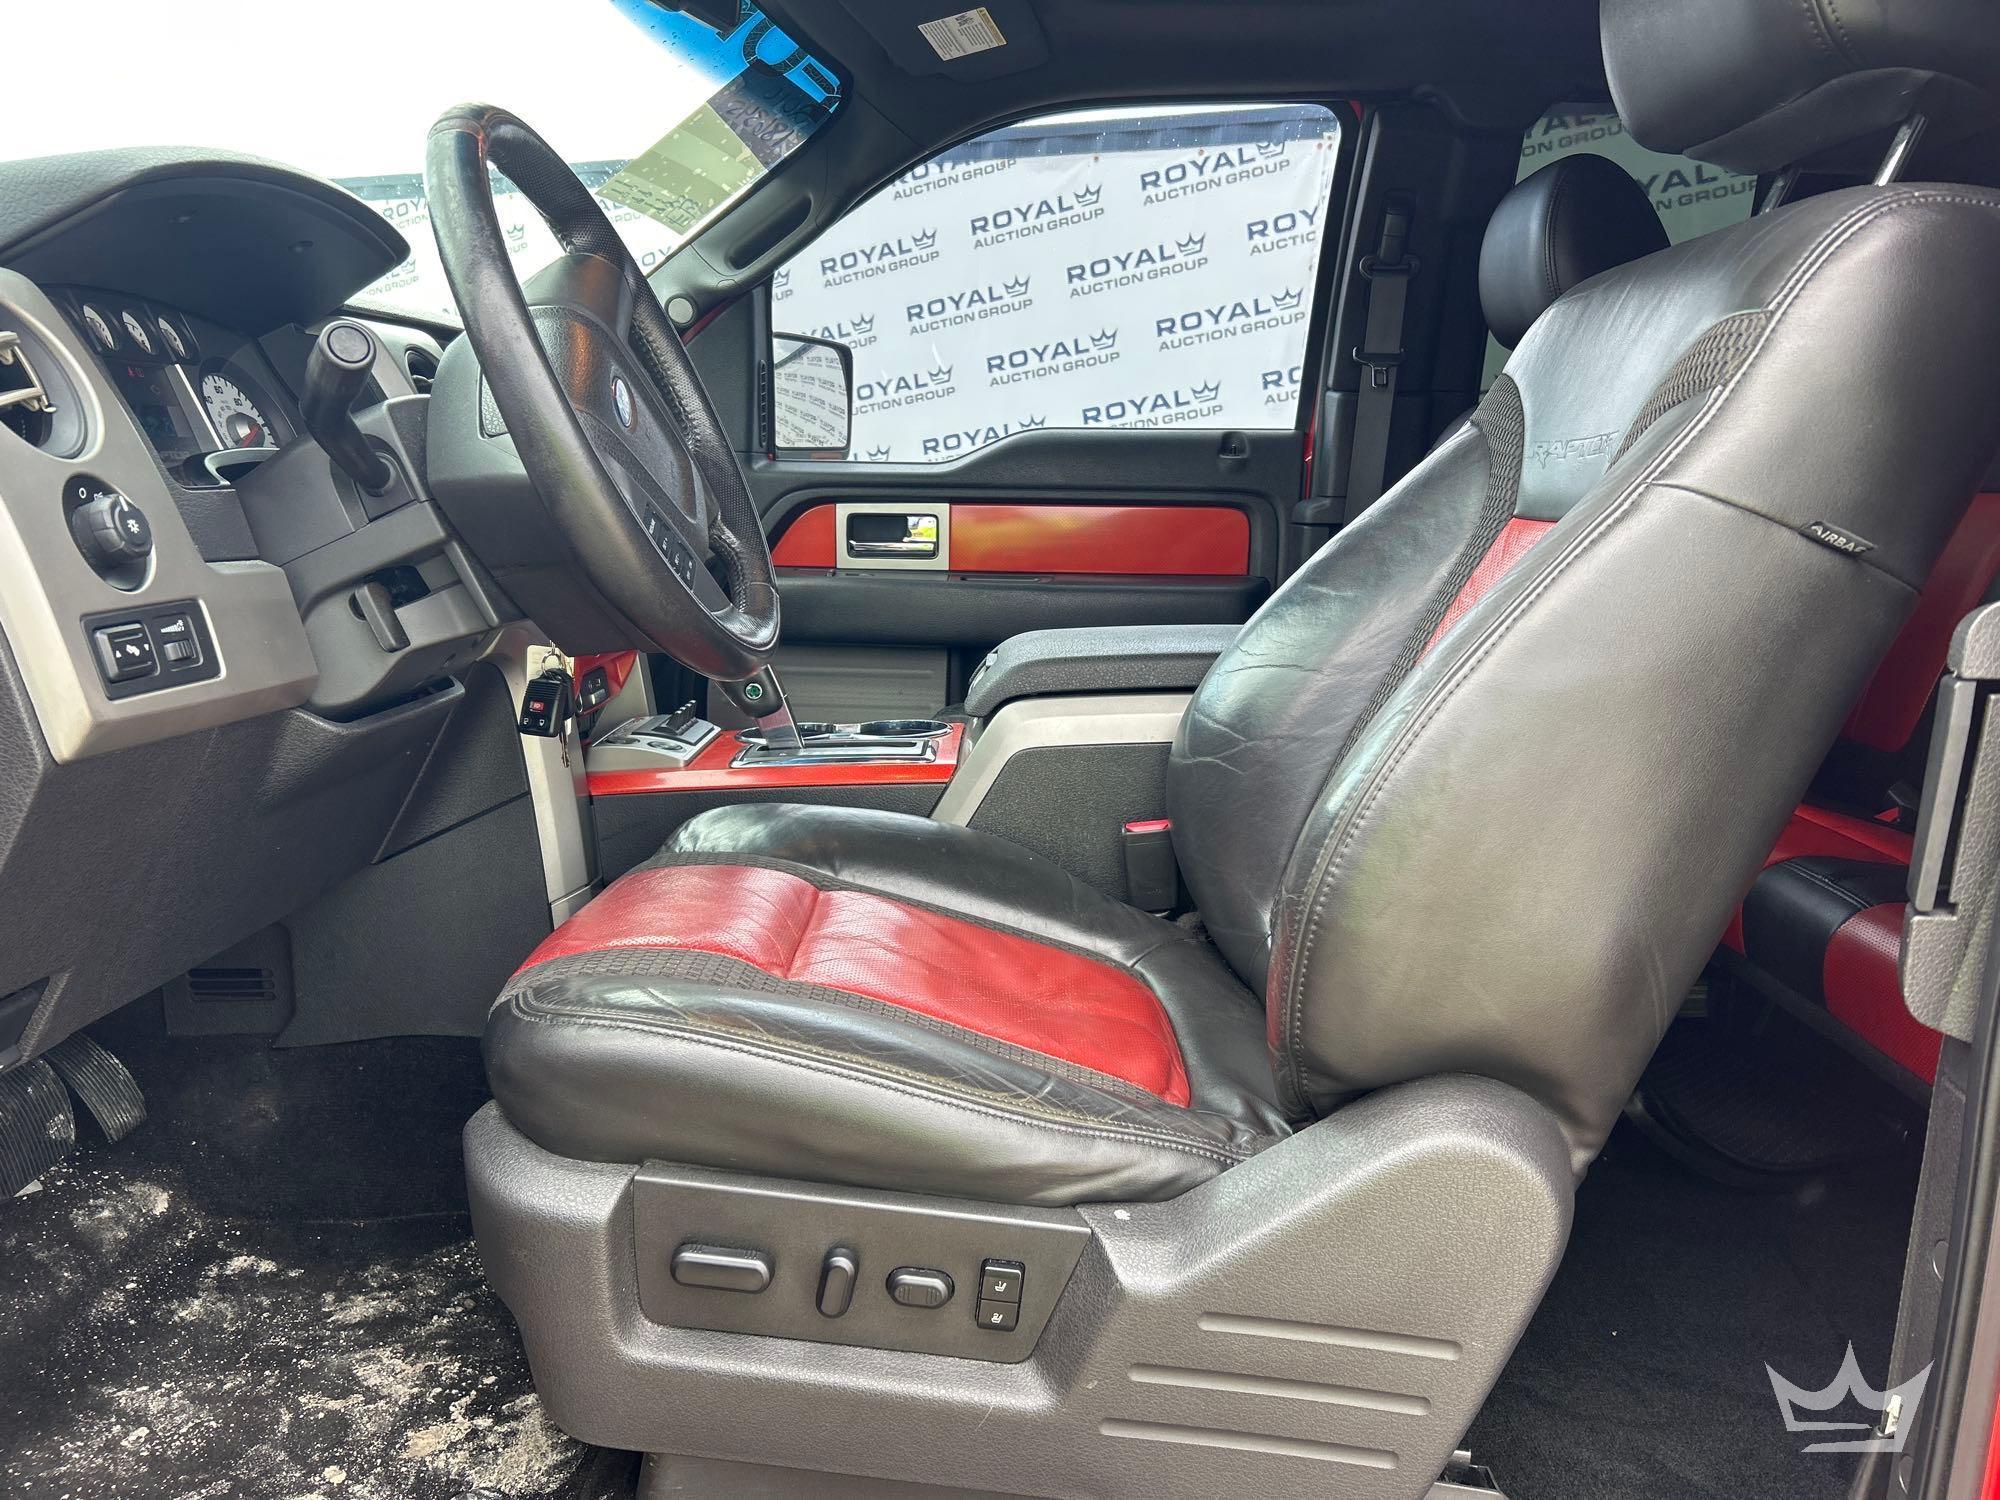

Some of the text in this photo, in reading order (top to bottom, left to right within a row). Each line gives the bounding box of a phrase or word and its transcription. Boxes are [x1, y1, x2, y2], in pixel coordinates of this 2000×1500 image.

[893, 175, 960, 201] AUCTION
[962, 158, 1017, 181] GROUP
[1140, 147, 1256, 192] ROYAL
[1143, 158, 1291, 207] AUCTION GROUP
[970, 195, 1074, 236] ROYAL
[973, 207, 1105, 250] AUCTION GROUP
[820, 238, 912, 276] ROYAL
[824, 250, 940, 288] AUCTION GROUP
[1066, 244, 1176, 284] ROYAL
[1070, 257, 1208, 298] AUCTION GROUP
[907, 286, 1003, 322] ROYAL
[910, 298, 1033, 336] AUCTION GROUP
[1156, 297, 1271, 337] ROYAL
[1158, 311, 1306, 352] AUCTION GROUP
[986, 337, 1090, 374] ROYAL
[990, 352, 1120, 387] AUCTION GROUP
[904, 386, 956, 406] GROUP
[1082, 390, 1190, 425] ROYAL
[1162, 404, 1224, 425] GROUP
